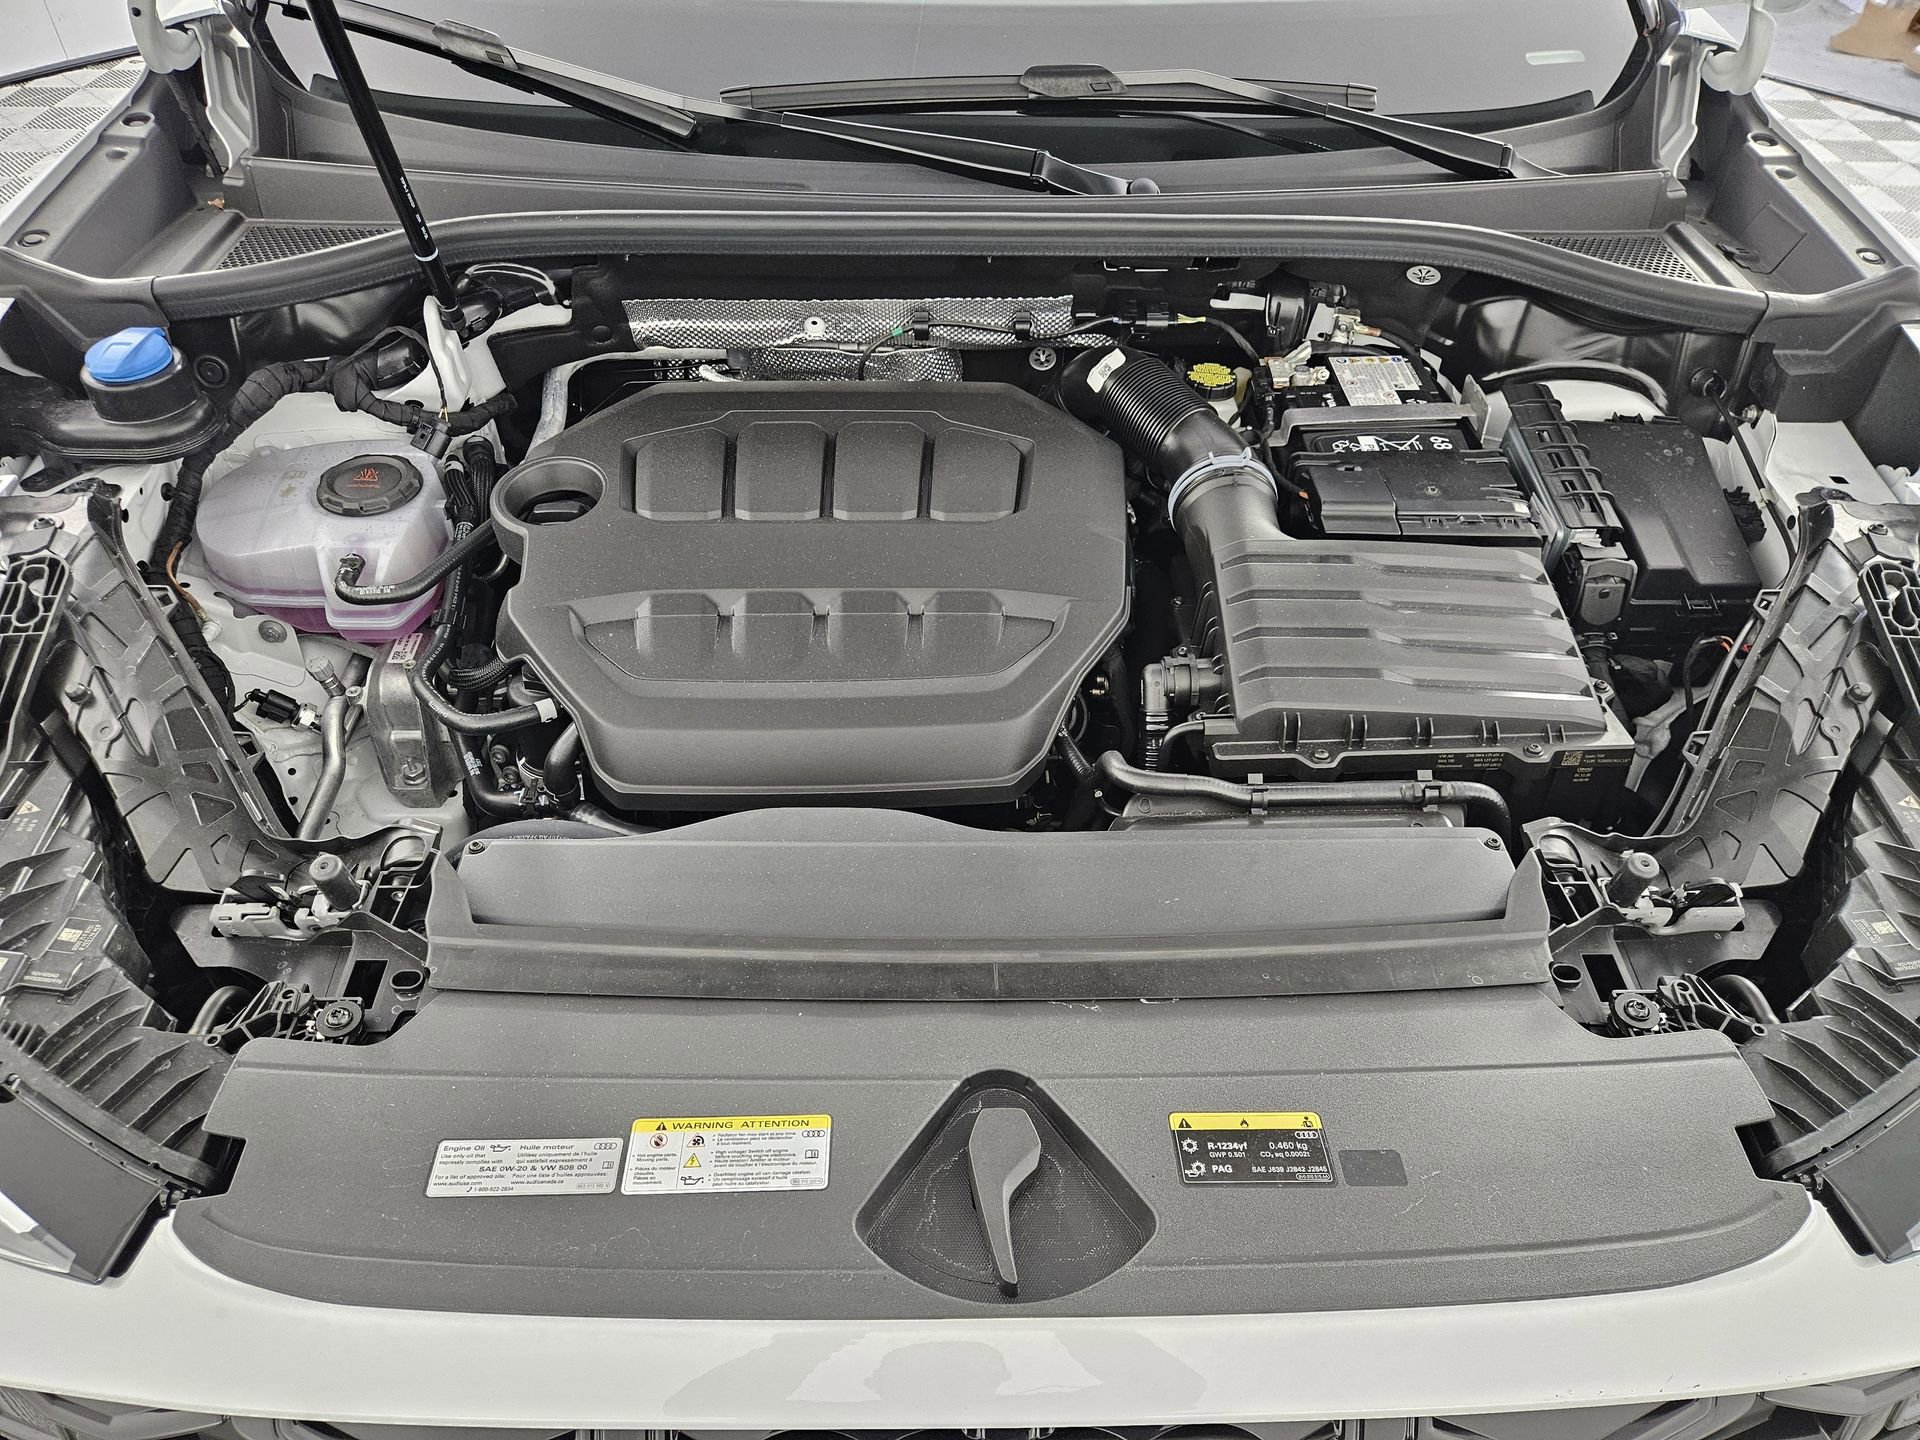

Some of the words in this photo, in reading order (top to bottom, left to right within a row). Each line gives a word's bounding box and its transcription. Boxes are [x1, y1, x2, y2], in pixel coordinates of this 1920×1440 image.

[672, 1121, 733, 1130] WARNING
[741, 1119, 810, 1128] ATTENTION
[1207, 1142, 1248, 1151] R-1234yf
[1296, 1142, 1308, 1150] kg
[1212, 1165, 1233, 1173] PAG
